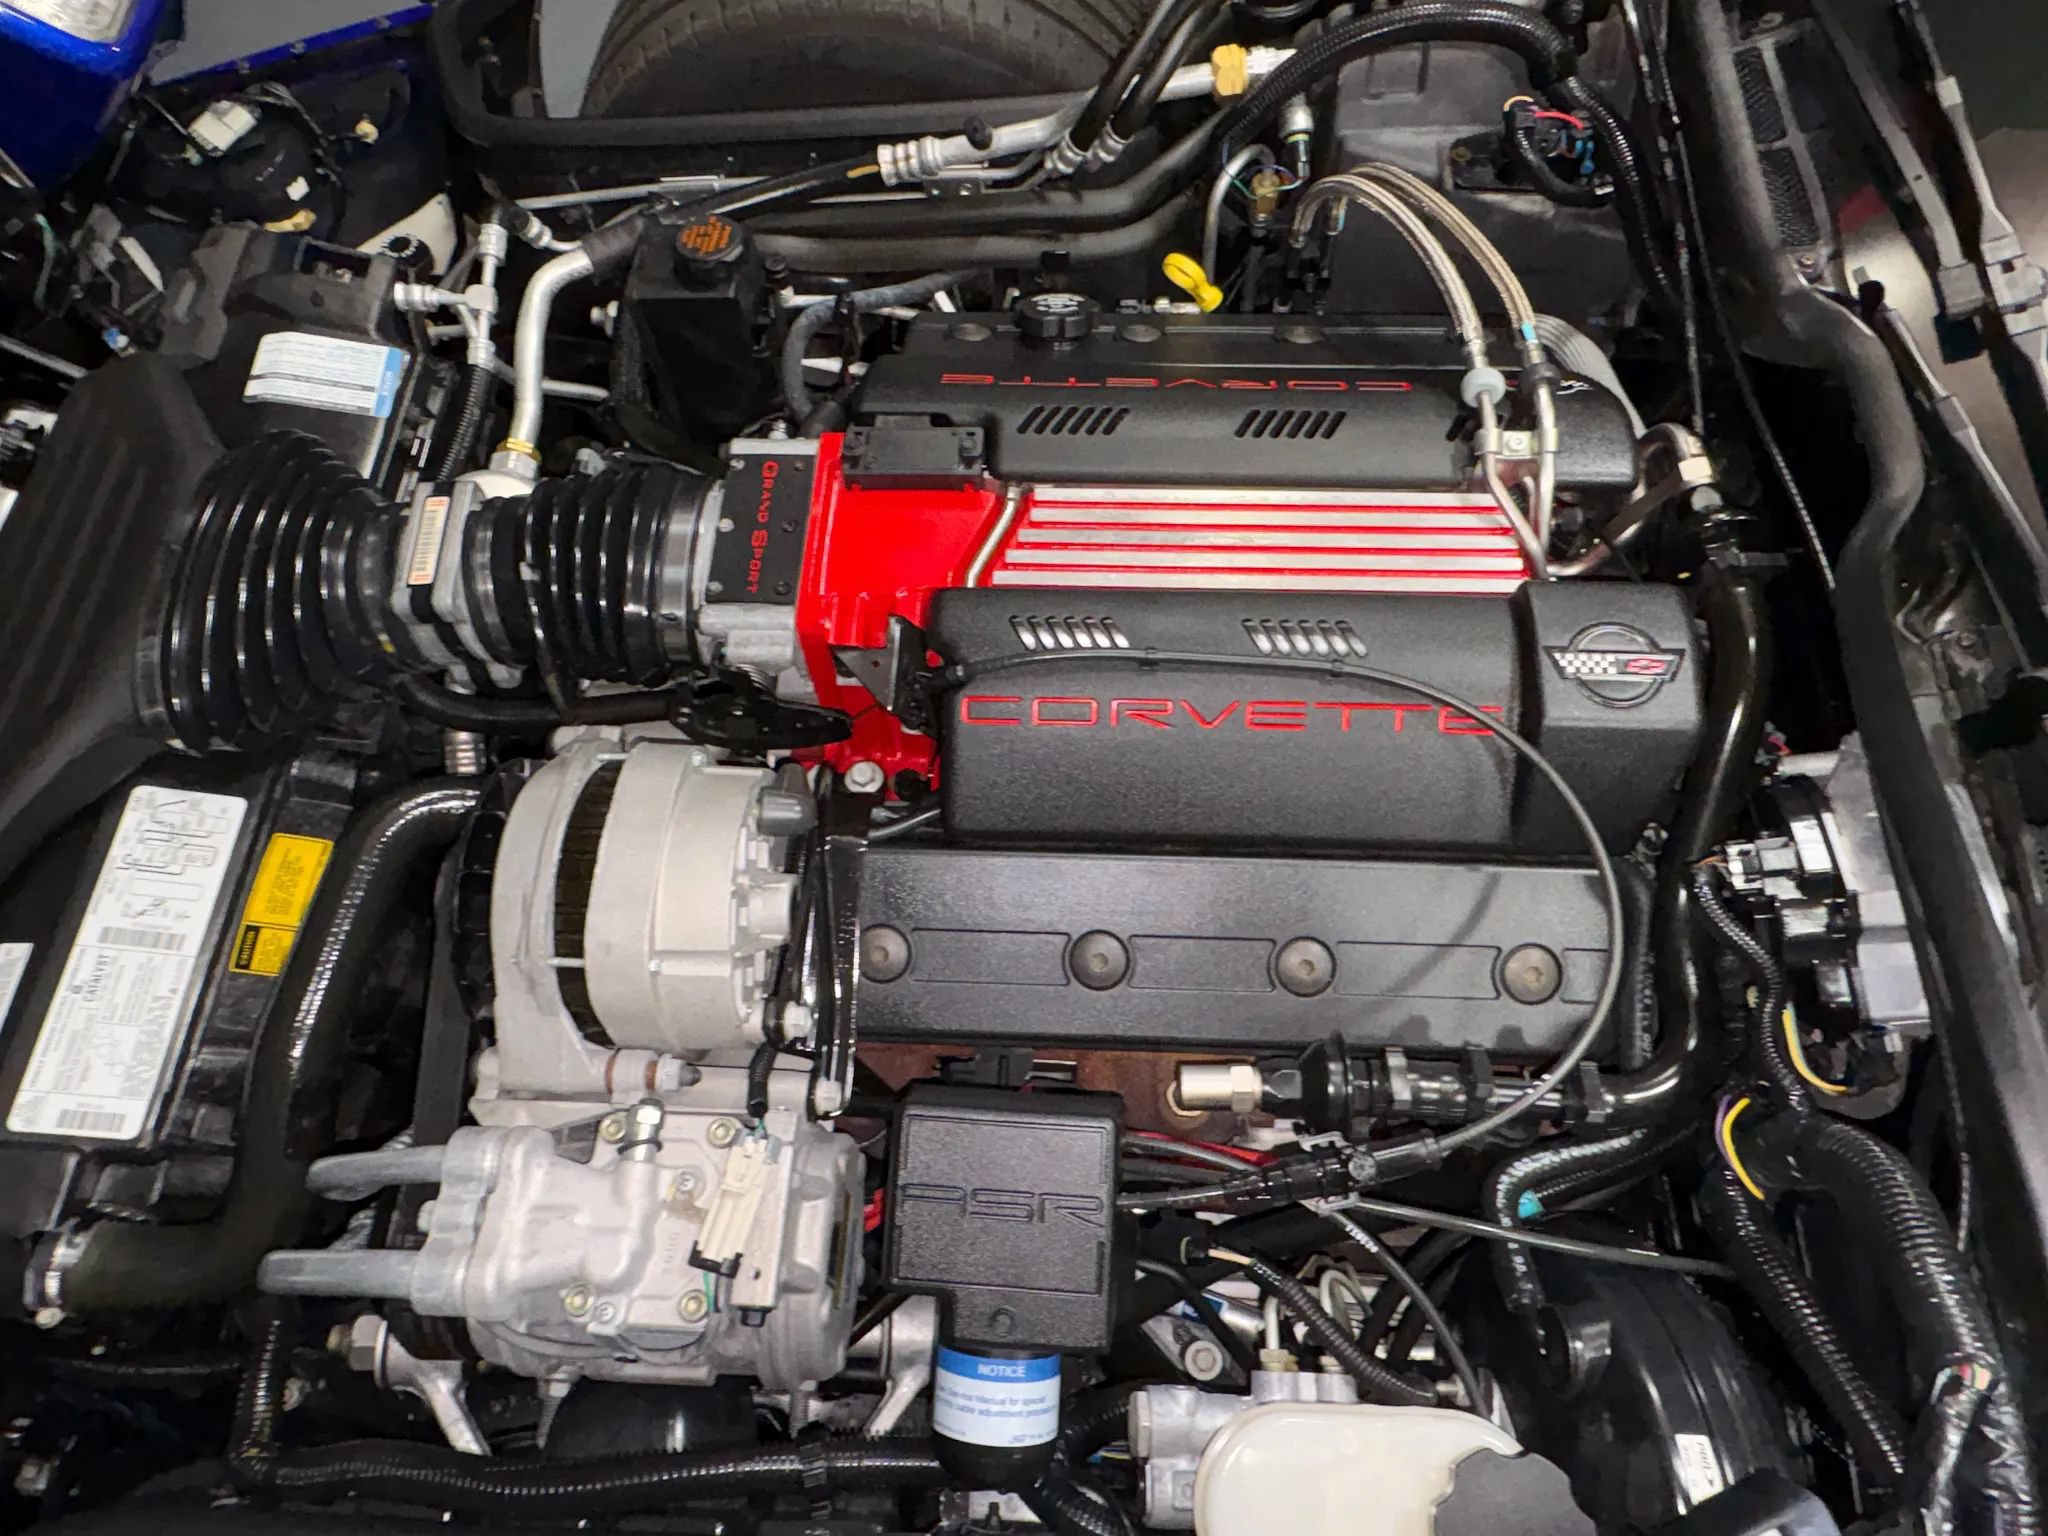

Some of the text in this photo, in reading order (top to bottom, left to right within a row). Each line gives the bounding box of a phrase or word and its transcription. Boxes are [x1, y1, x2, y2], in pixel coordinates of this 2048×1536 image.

[941, 372, 1412, 391] CORVETTE
[746, 460, 779, 594] GRAND SPORT
[960, 695, 1502, 736] CORVETTE
[899, 1182, 1105, 1228] ASR
[977, 1363, 1027, 1378] NOTICE
